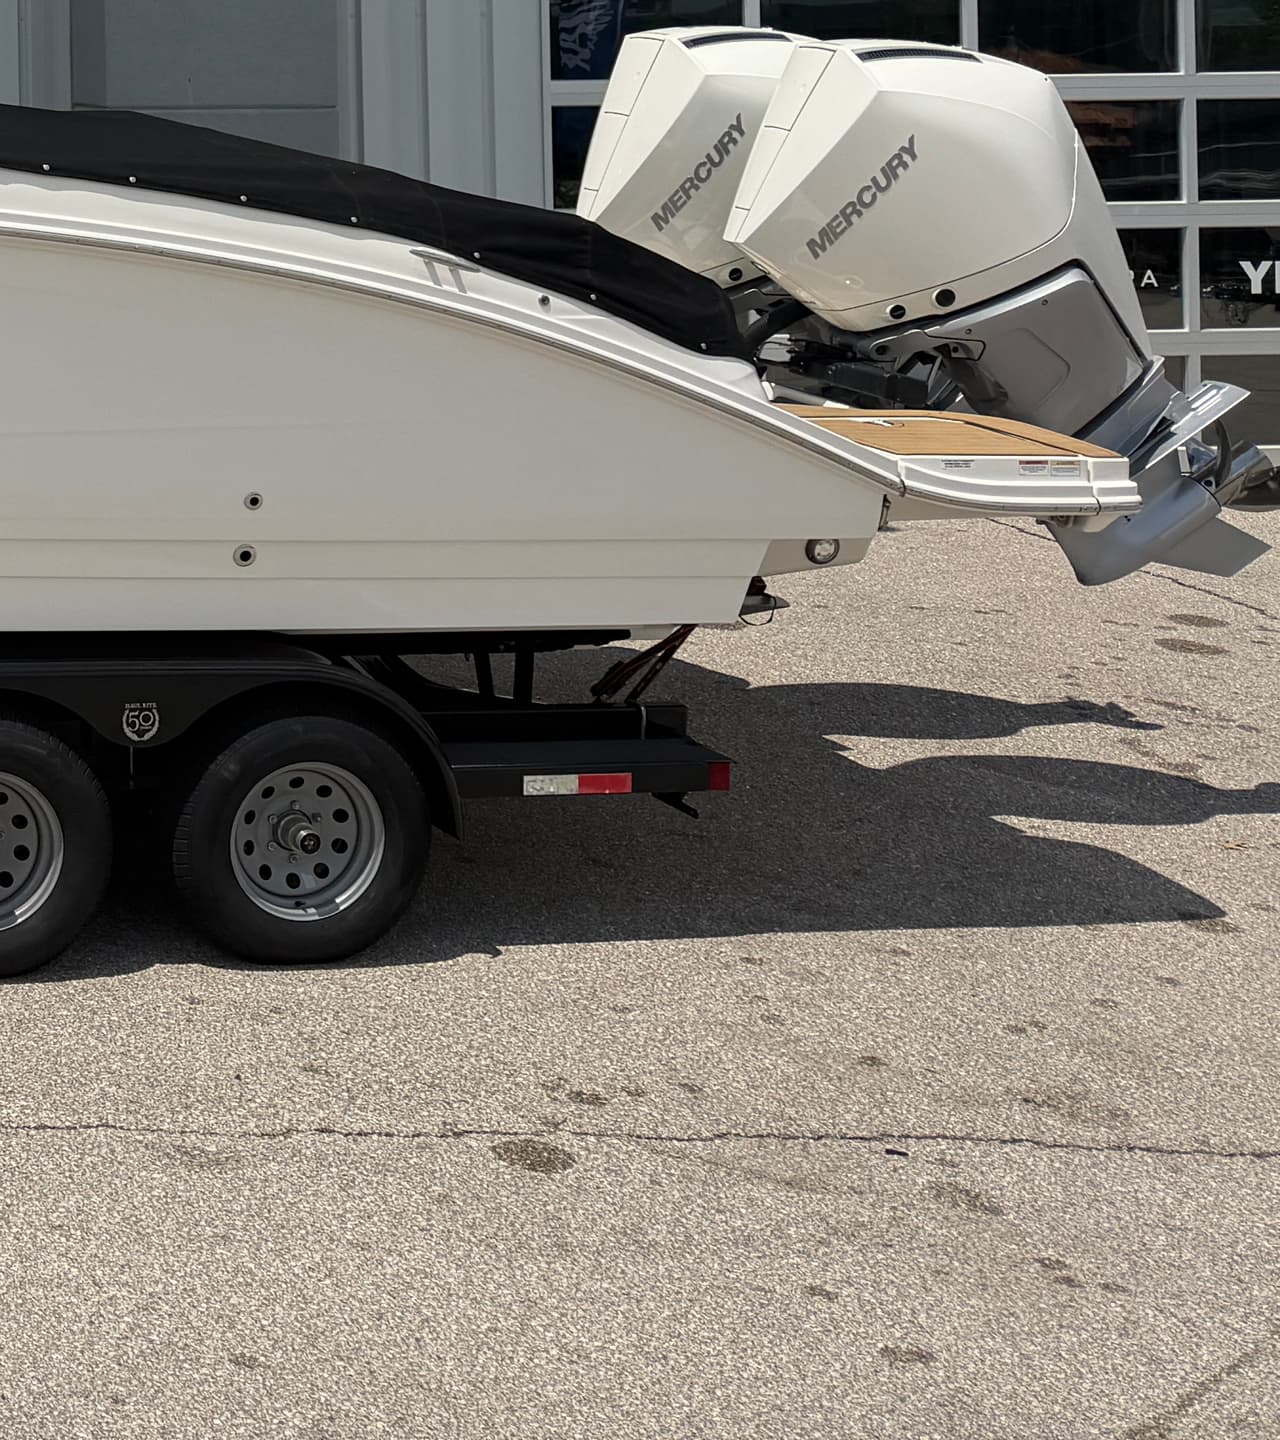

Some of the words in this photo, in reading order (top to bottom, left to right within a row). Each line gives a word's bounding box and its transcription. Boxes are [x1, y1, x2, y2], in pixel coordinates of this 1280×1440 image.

[650, 111, 747, 232] MERCURY
[805, 133, 920, 261] MERCURY
[129, 709, 154, 732] 50
